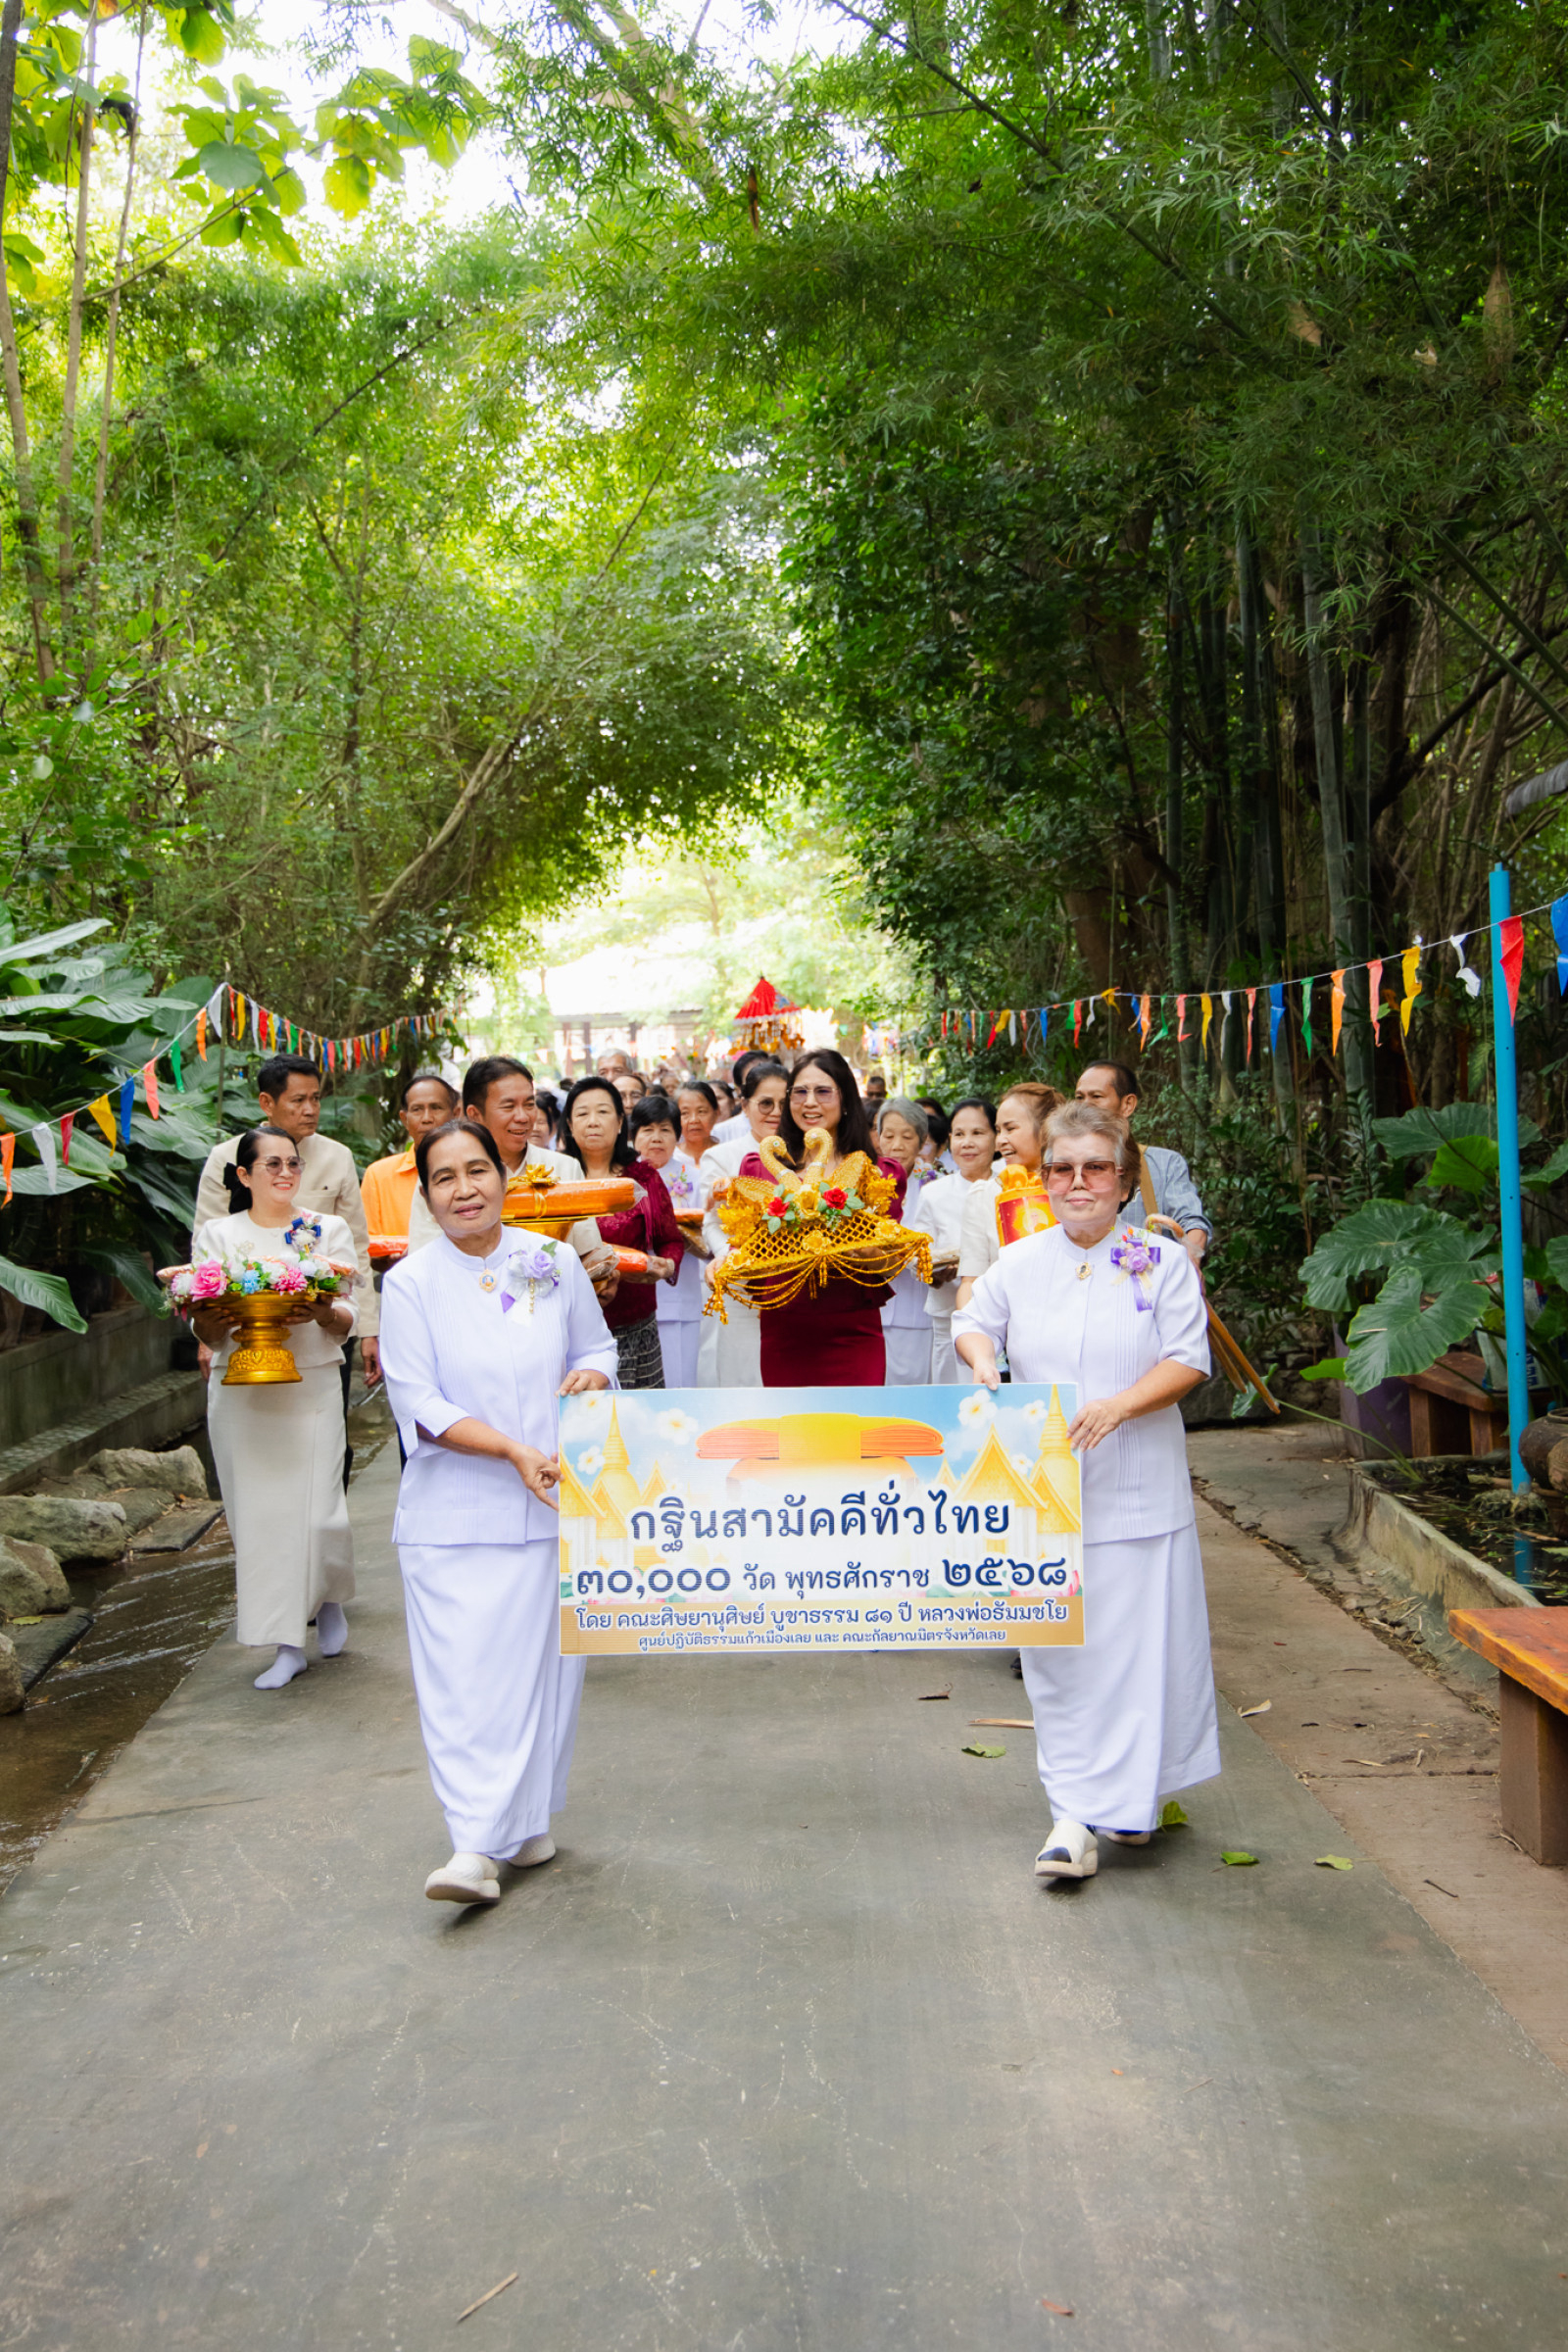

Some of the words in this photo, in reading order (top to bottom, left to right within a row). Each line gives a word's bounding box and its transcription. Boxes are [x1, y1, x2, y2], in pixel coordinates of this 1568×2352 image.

[630, 1480, 1009, 1552] กฐินสามัคคีทั่วไทย
[577, 1567, 730, 1599] ๓๐,๐๐๐
[743, 1563, 775, 1591] วัด
[785, 1561, 930, 1599] พุทธศักราช
[942, 1556, 1067, 1588] ๒๕๖๘
[575, 1608, 612, 1629] โดย
[618, 1603, 764, 1633] คณะศิษยานุศิษย์
[770, 1609, 859, 1631] บูชาธรรม
[865, 1610, 893, 1624] ๘๑
[899, 1601, 911, 1623] ปี
[918, 1599, 1067, 1623] หลวงพ่อธัมมชโย
[815, 1631, 839, 1642] และ
[843, 1627, 1006, 1643] คณะกัลยาณมิตรจังหวัดเลย
